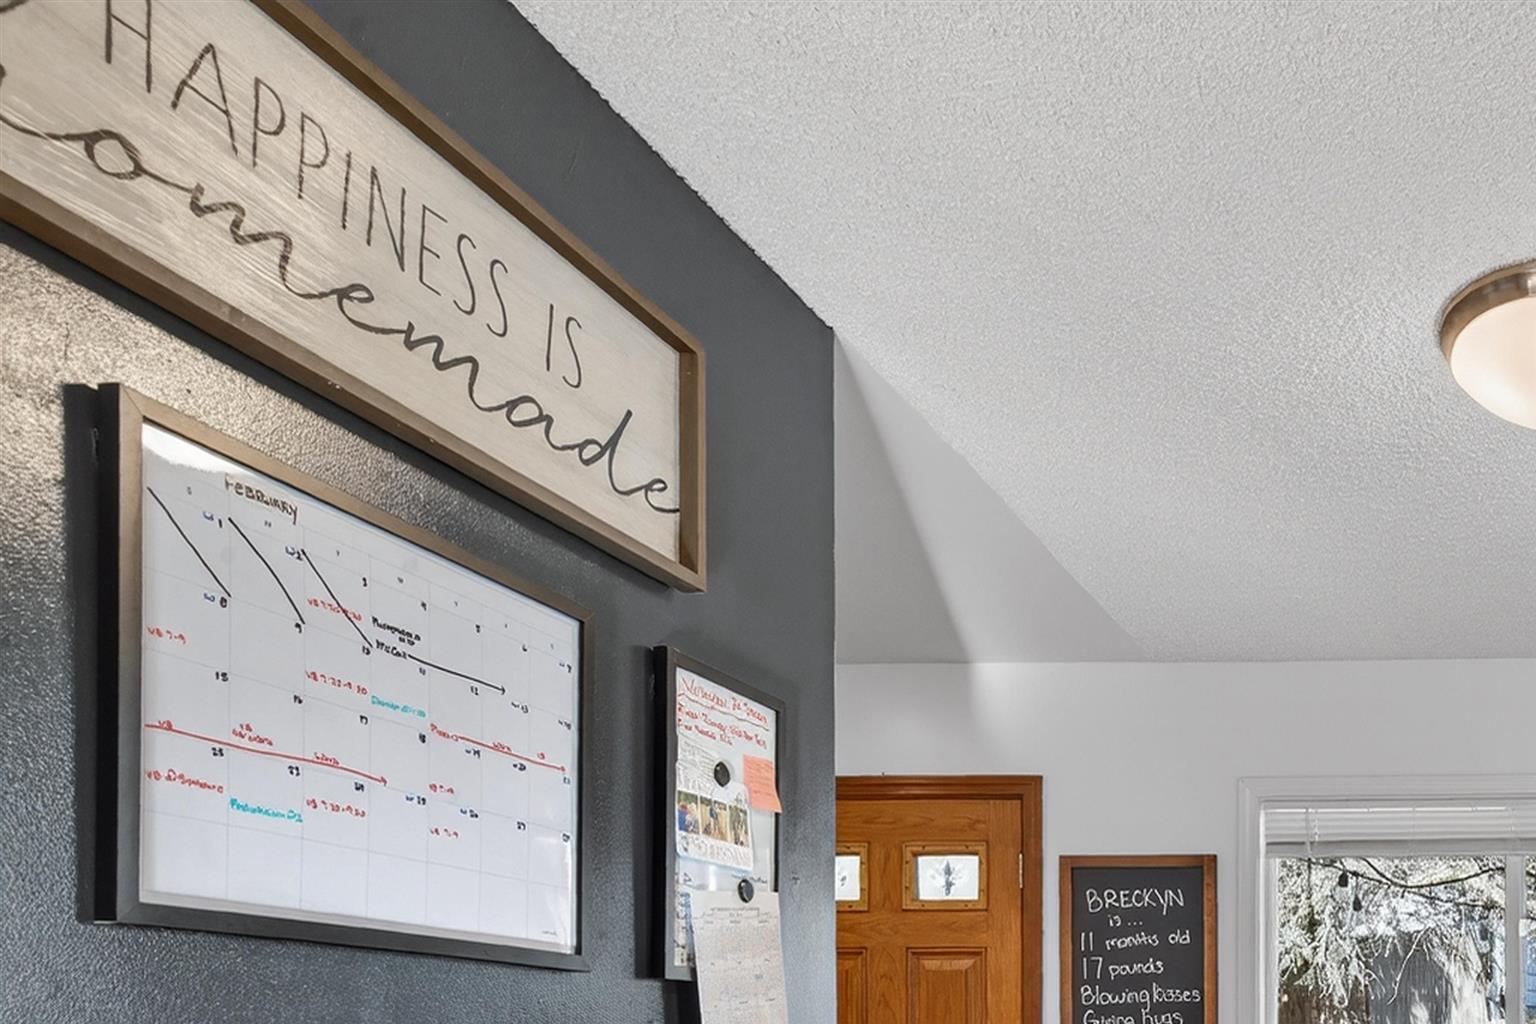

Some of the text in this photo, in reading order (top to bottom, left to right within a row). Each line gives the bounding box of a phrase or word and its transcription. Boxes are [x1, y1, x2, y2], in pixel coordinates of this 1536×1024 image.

[103, 0, 582, 389] HAPPINESS IS
[0, 64, 680, 514] omemade
[1086, 888, 1185, 916] BRECKYN
[1080, 929, 1192, 951] 11 months old
[1082, 956, 1164, 980] 17 pounds
[1080, 984, 1150, 1012] Blowing
